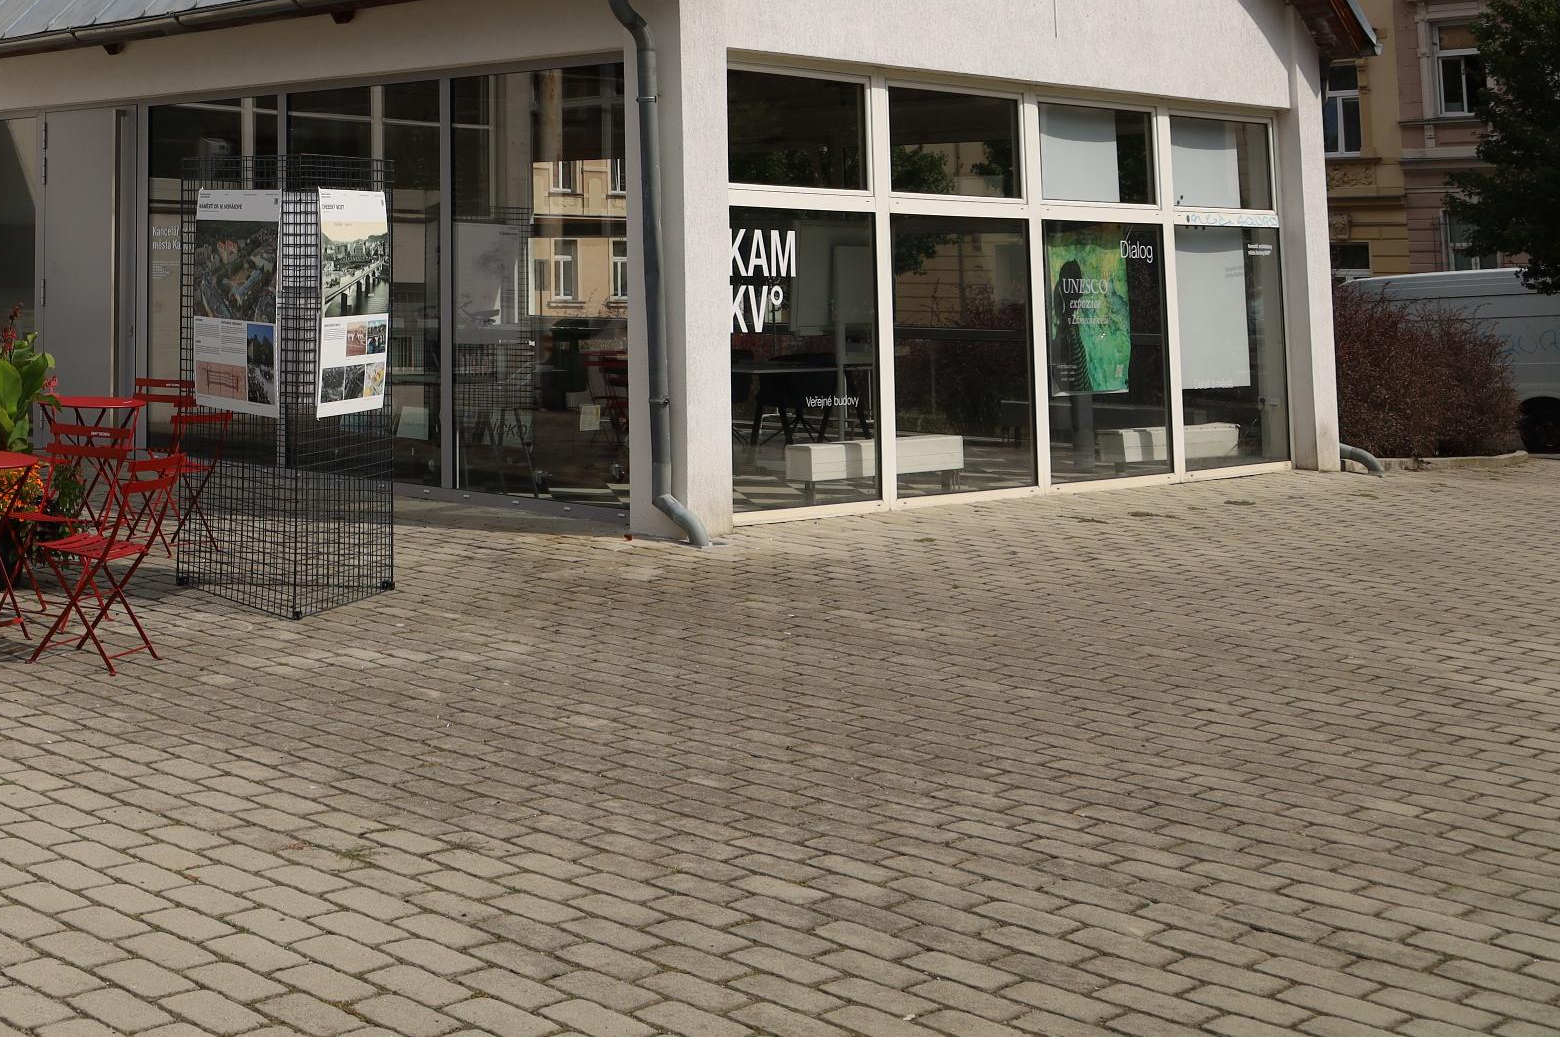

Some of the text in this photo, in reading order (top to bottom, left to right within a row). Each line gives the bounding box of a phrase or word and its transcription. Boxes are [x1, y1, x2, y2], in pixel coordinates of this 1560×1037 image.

[729, 228, 797, 277] KAM
[1120, 240, 1154, 264] Dialog
[1062, 278, 1109, 294] UNESCO
[806, 395, 859, 410] Veřejné budovy
